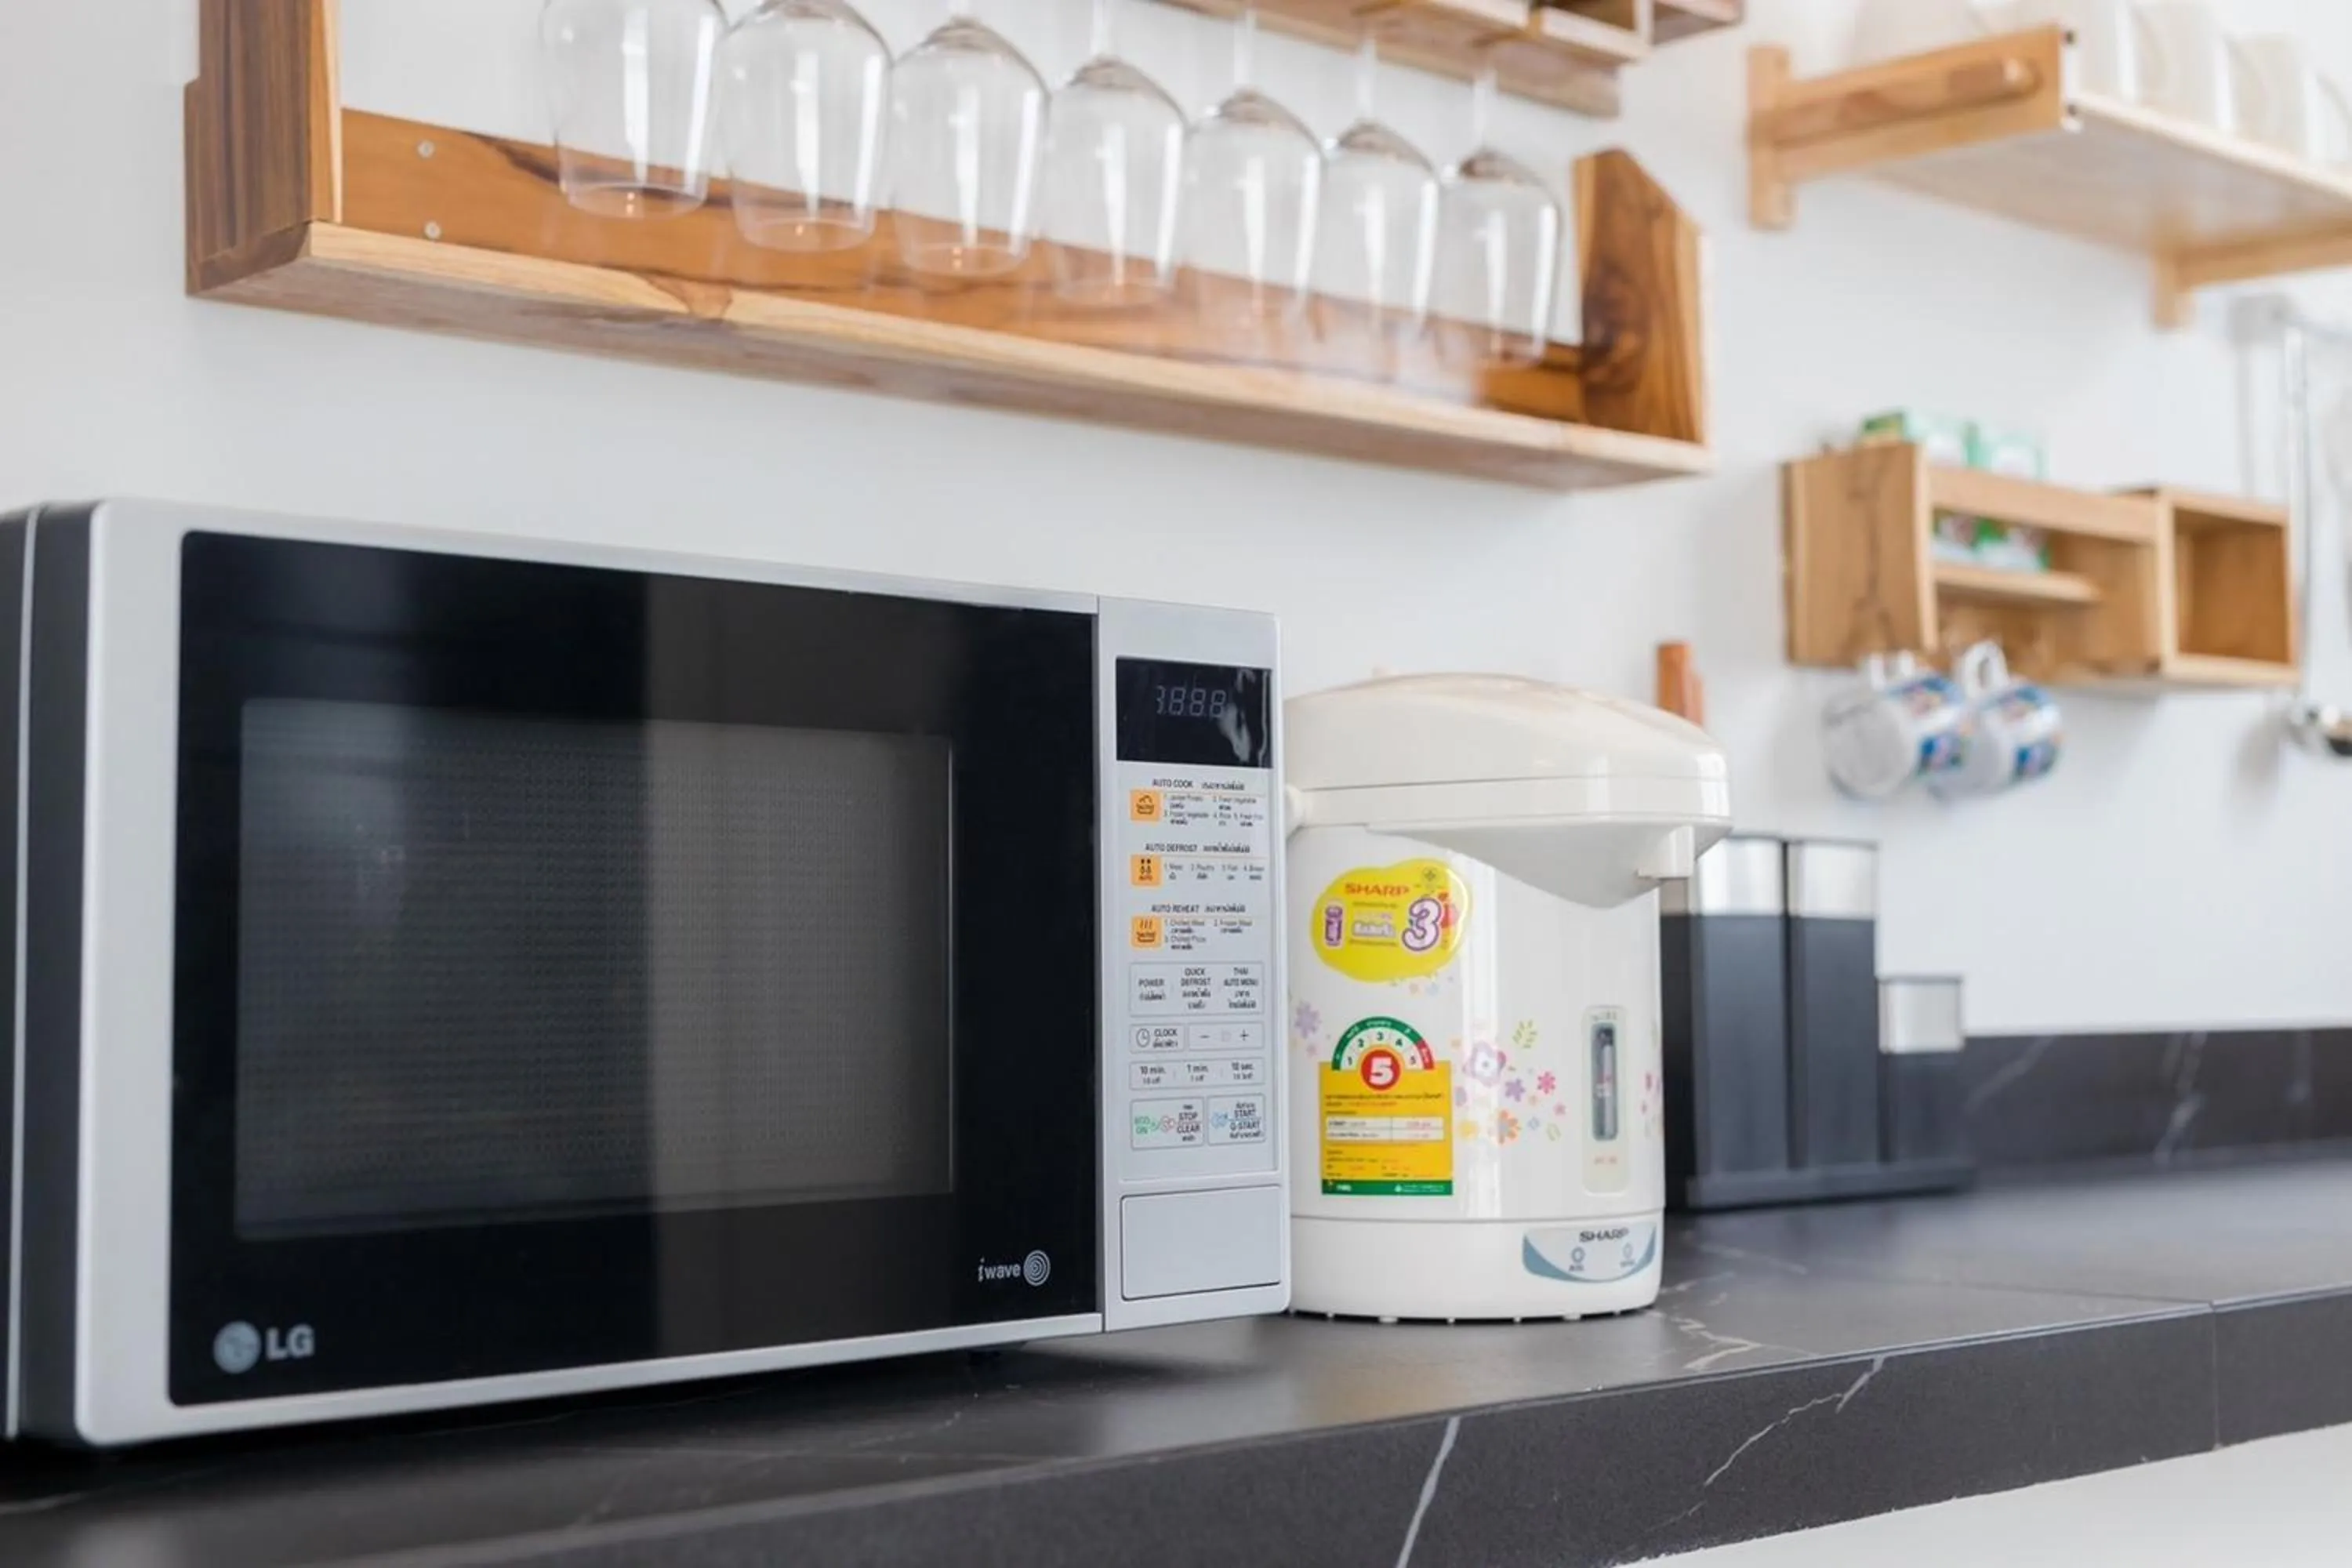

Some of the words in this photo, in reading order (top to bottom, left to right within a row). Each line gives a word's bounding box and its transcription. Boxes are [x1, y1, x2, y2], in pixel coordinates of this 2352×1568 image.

[1152, 779, 1172, 788] AUTO
[1172, 779, 1194, 789] COOK
[1145, 843, 1166, 852] AUTO
[1166, 843, 1198, 852] DEFROST
[1344, 882, 1410, 898] SHARP
[1151, 903, 1171, 913] AUTO
[1171, 904, 1200, 913] REHEAT
[1402, 896, 1443, 952] 3
[1184, 967, 1207, 977] QUICK
[1138, 978, 1165, 987] POWER
[1180, 978, 1211, 987] DEFROST
[1223, 978, 1241, 987] AUTO
[1240, 978, 1259, 986] MENU
[1153, 1028, 1178, 1037] CLOCK
[1376, 1032, 1385, 1041] 3
[1357, 1038, 1365, 1048] 2
[1395, 1038, 1403, 1047] 4
[1347, 1056, 1353, 1065] 1
[1410, 1055, 1417, 1065] 5
[1139, 1065, 1149, 1075] 10
[1368, 1056, 1394, 1086] 5
[1178, 1112, 1198, 1121] STOP
[1233, 1108, 1257, 1117] START
[1177, 1124, 1200, 1134] CLEAR
[1579, 1226, 1629, 1243] SHARP
[266, 1323, 315, 1362] LG
